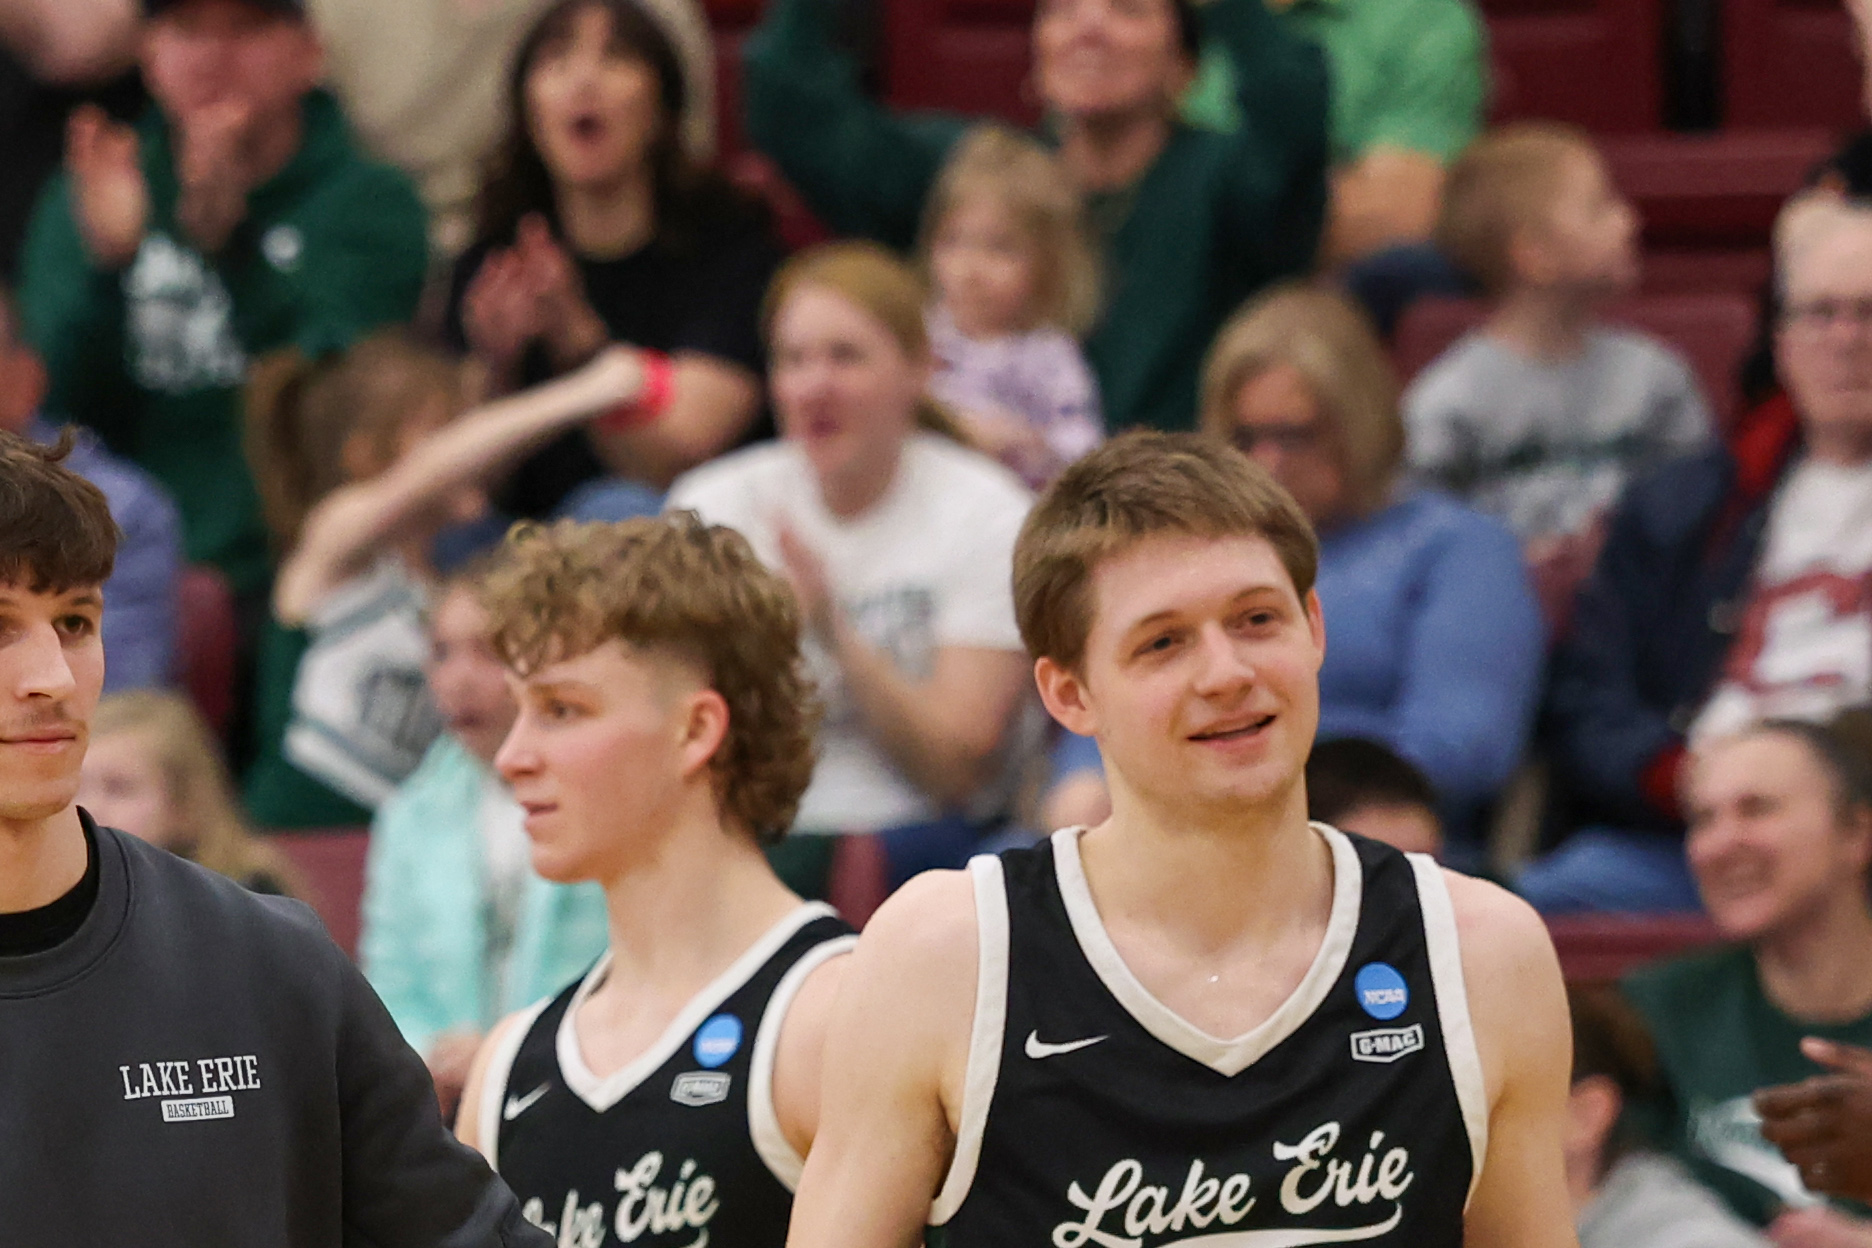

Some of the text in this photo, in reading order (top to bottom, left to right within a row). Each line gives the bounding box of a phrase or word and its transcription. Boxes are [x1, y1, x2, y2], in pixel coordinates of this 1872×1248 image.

[119, 1055, 261, 1100] LAKE ERIE
[166, 1100, 229, 1119] BASKETBALL
[614, 1150, 721, 1243] Erie
[1273, 1121, 1414, 1214] Erie
